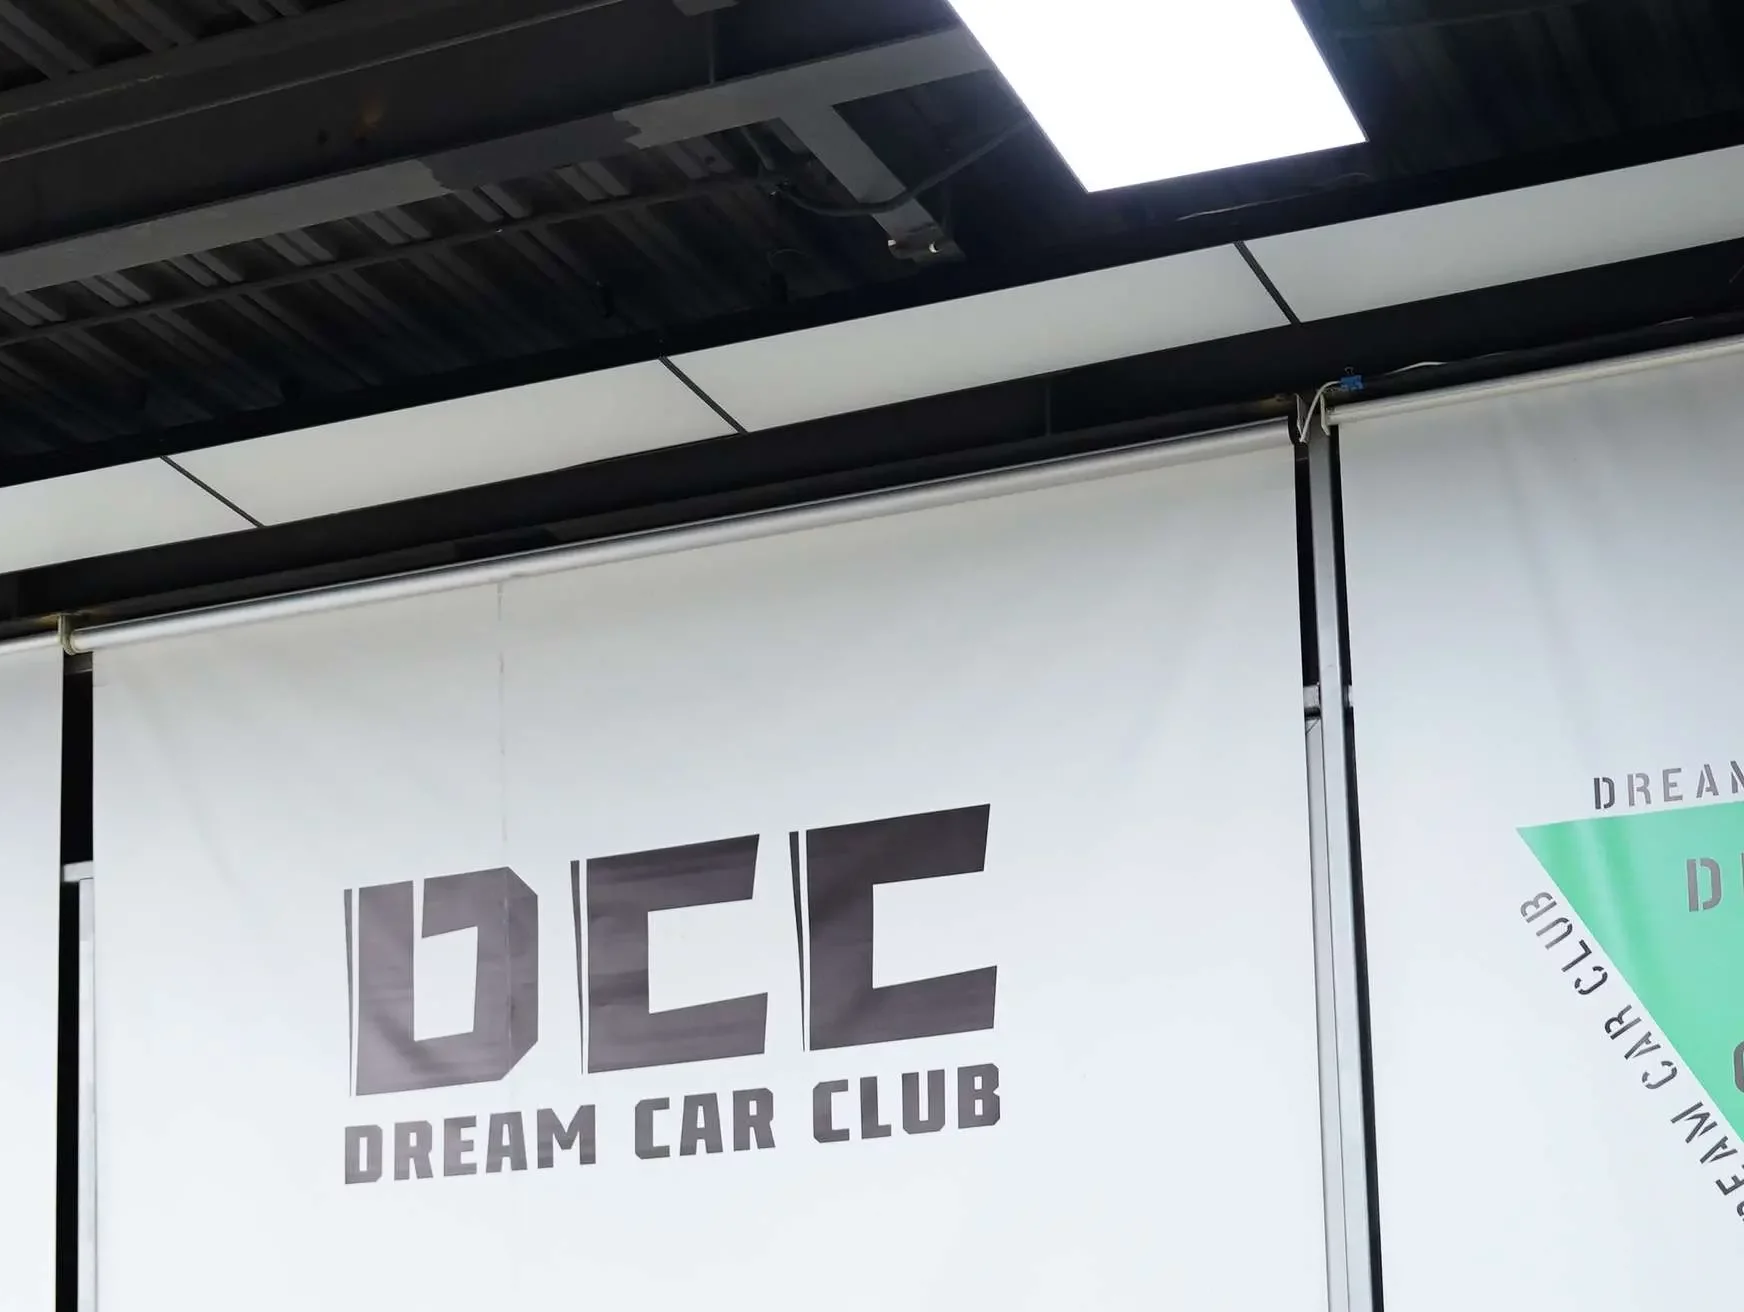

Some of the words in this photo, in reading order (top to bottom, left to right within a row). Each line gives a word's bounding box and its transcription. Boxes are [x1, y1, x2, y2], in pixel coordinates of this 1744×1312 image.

[343, 803, 998, 1098] DCC
[1520, 890, 1609, 996] CLUB
[1604, 1004, 1678, 1091] CAR
[343, 1104, 597, 1185] DREAM
[634, 1087, 776, 1160] CAR
[812, 1062, 1002, 1144] CLUB
